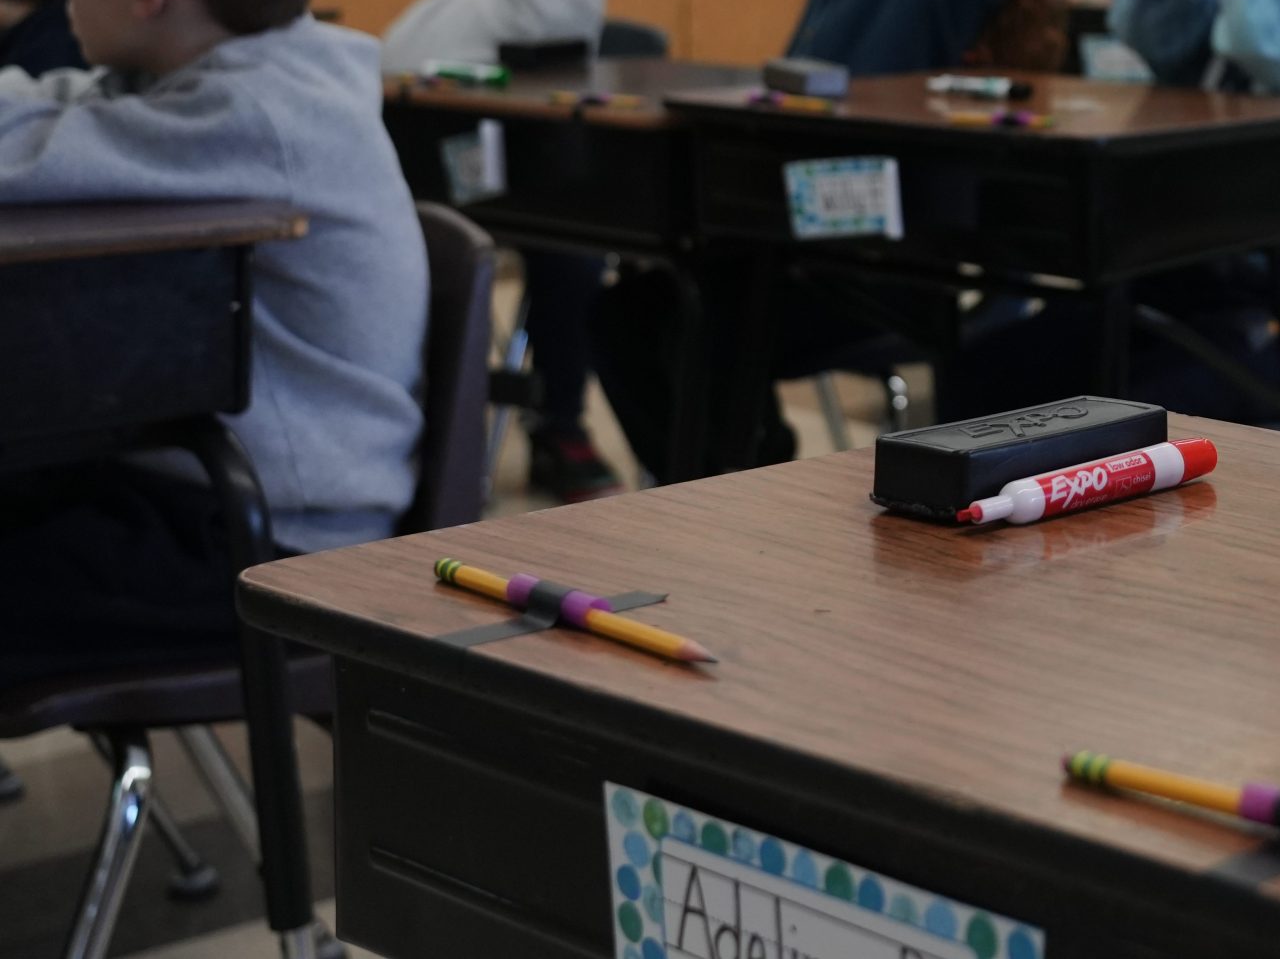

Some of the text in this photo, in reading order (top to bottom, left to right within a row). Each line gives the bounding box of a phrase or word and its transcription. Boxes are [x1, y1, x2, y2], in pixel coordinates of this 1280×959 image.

[959, 406, 1089, 438] EXPO
[1109, 455, 1144, 473] low odor
[1050, 467, 1108, 509] EXPO
[1132, 472, 1152, 485] chisel
